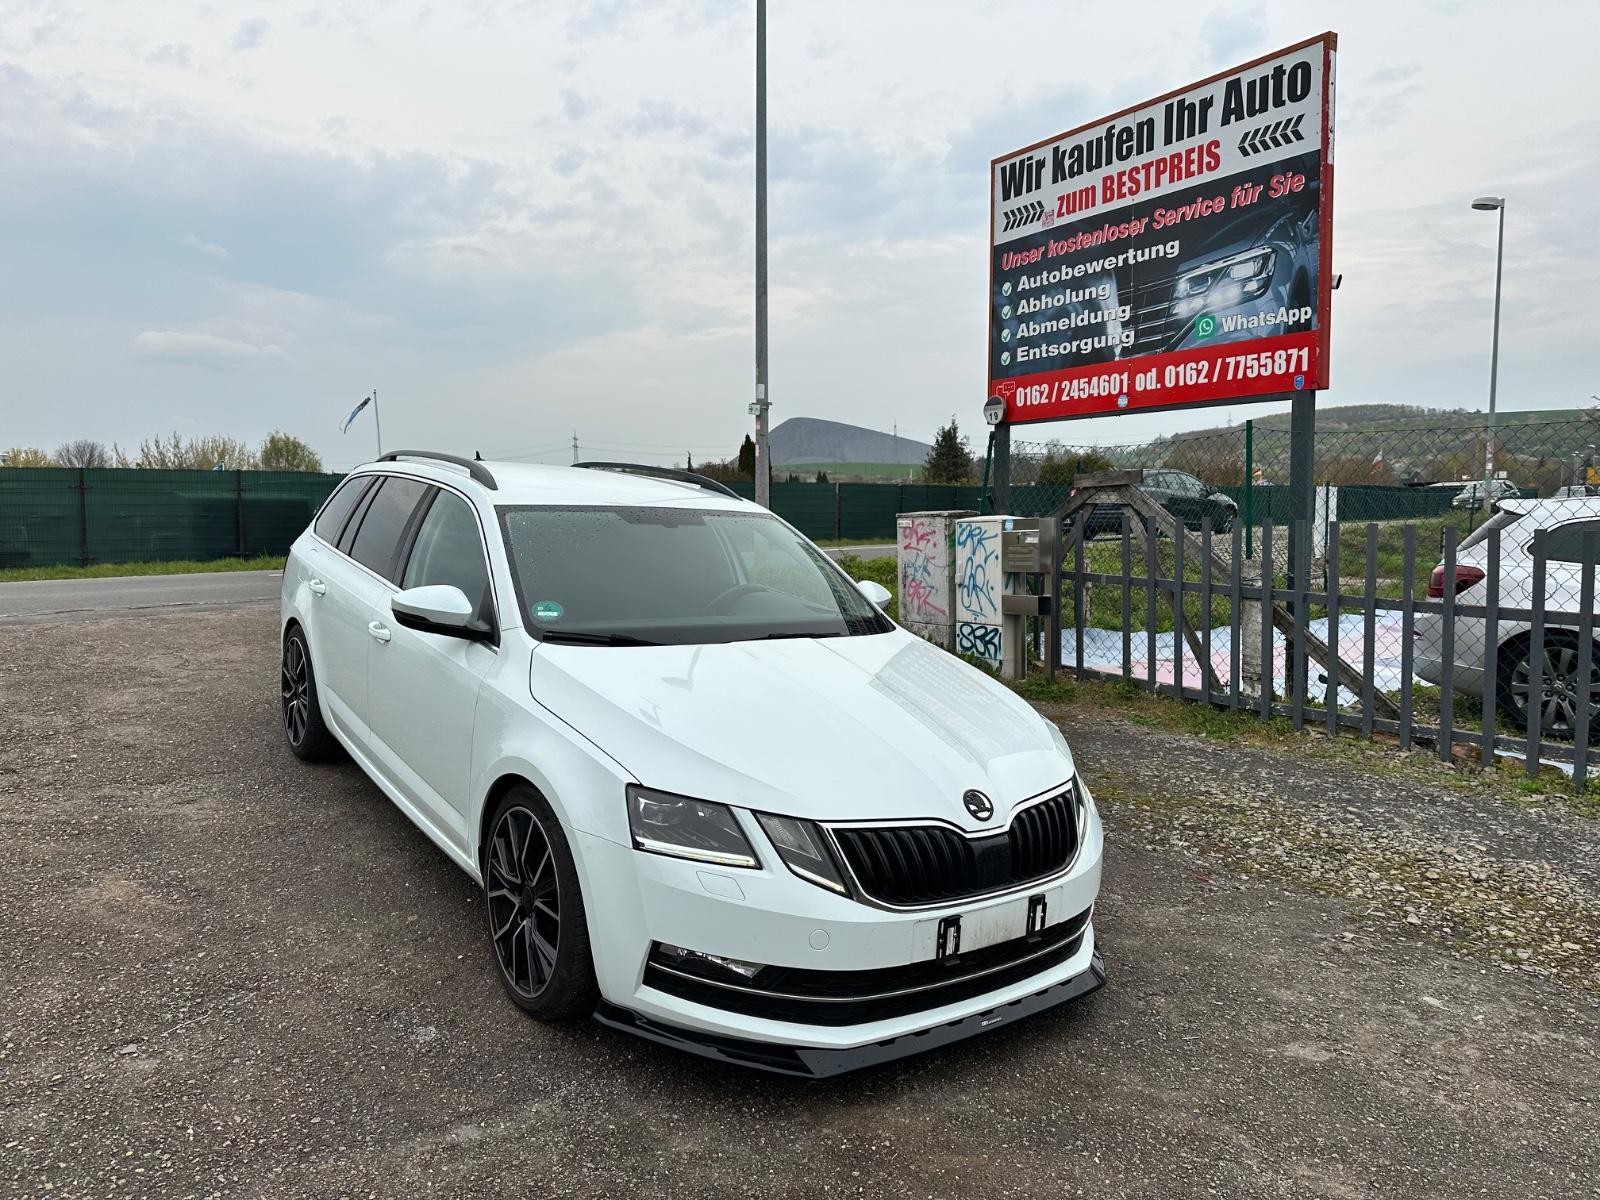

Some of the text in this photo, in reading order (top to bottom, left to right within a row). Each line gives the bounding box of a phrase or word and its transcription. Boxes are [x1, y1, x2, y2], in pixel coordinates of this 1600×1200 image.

[1000, 60, 1312, 202] Wir kaufen Ihr Auto
[1056, 139, 1221, 219] zum BESTPREIS
[1001, 171, 1306, 271] Unser kostenloser Service für Sie
[1016, 239, 1180, 292] Autobewertung
[1016, 283, 1112, 316] Abholung
[1016, 303, 1131, 339] Abmeldung
[1222, 305, 1313, 333] WhatsApp
[1016, 329, 1135, 362] Entsorgung
[1016, 383, 1049, 408] 0162
[1061, 371, 1129, 402] 2454601
[1135, 367, 1161, 392] od.
[1164, 360, 1209, 388] 0162
[1226, 346, 1309, 381] 7755871
